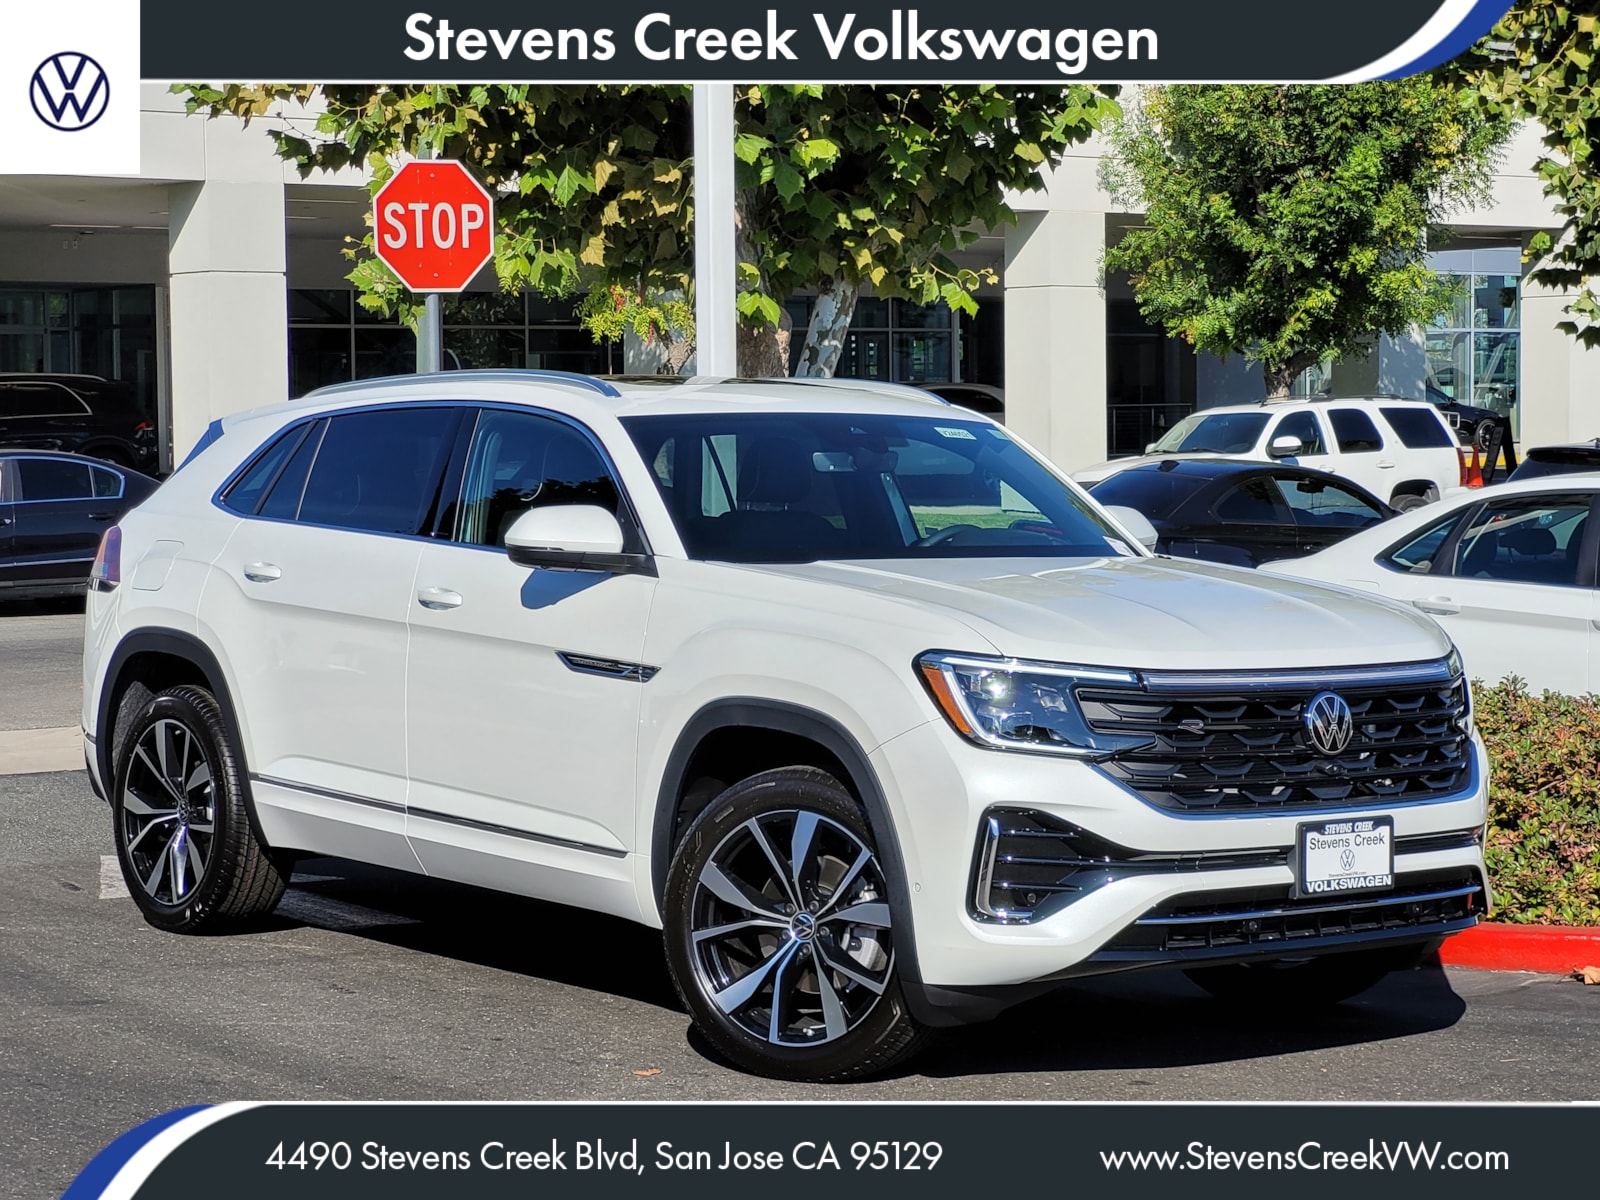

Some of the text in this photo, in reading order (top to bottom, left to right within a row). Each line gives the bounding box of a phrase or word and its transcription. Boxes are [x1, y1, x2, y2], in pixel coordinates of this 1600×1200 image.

[383, 201, 485, 250] STOP
[1324, 821, 1374, 834] STEVENS CREEK
[1309, 832, 1385, 850] Stevens Creek
[1306, 875, 1392, 893] VOLKSWAGEN
